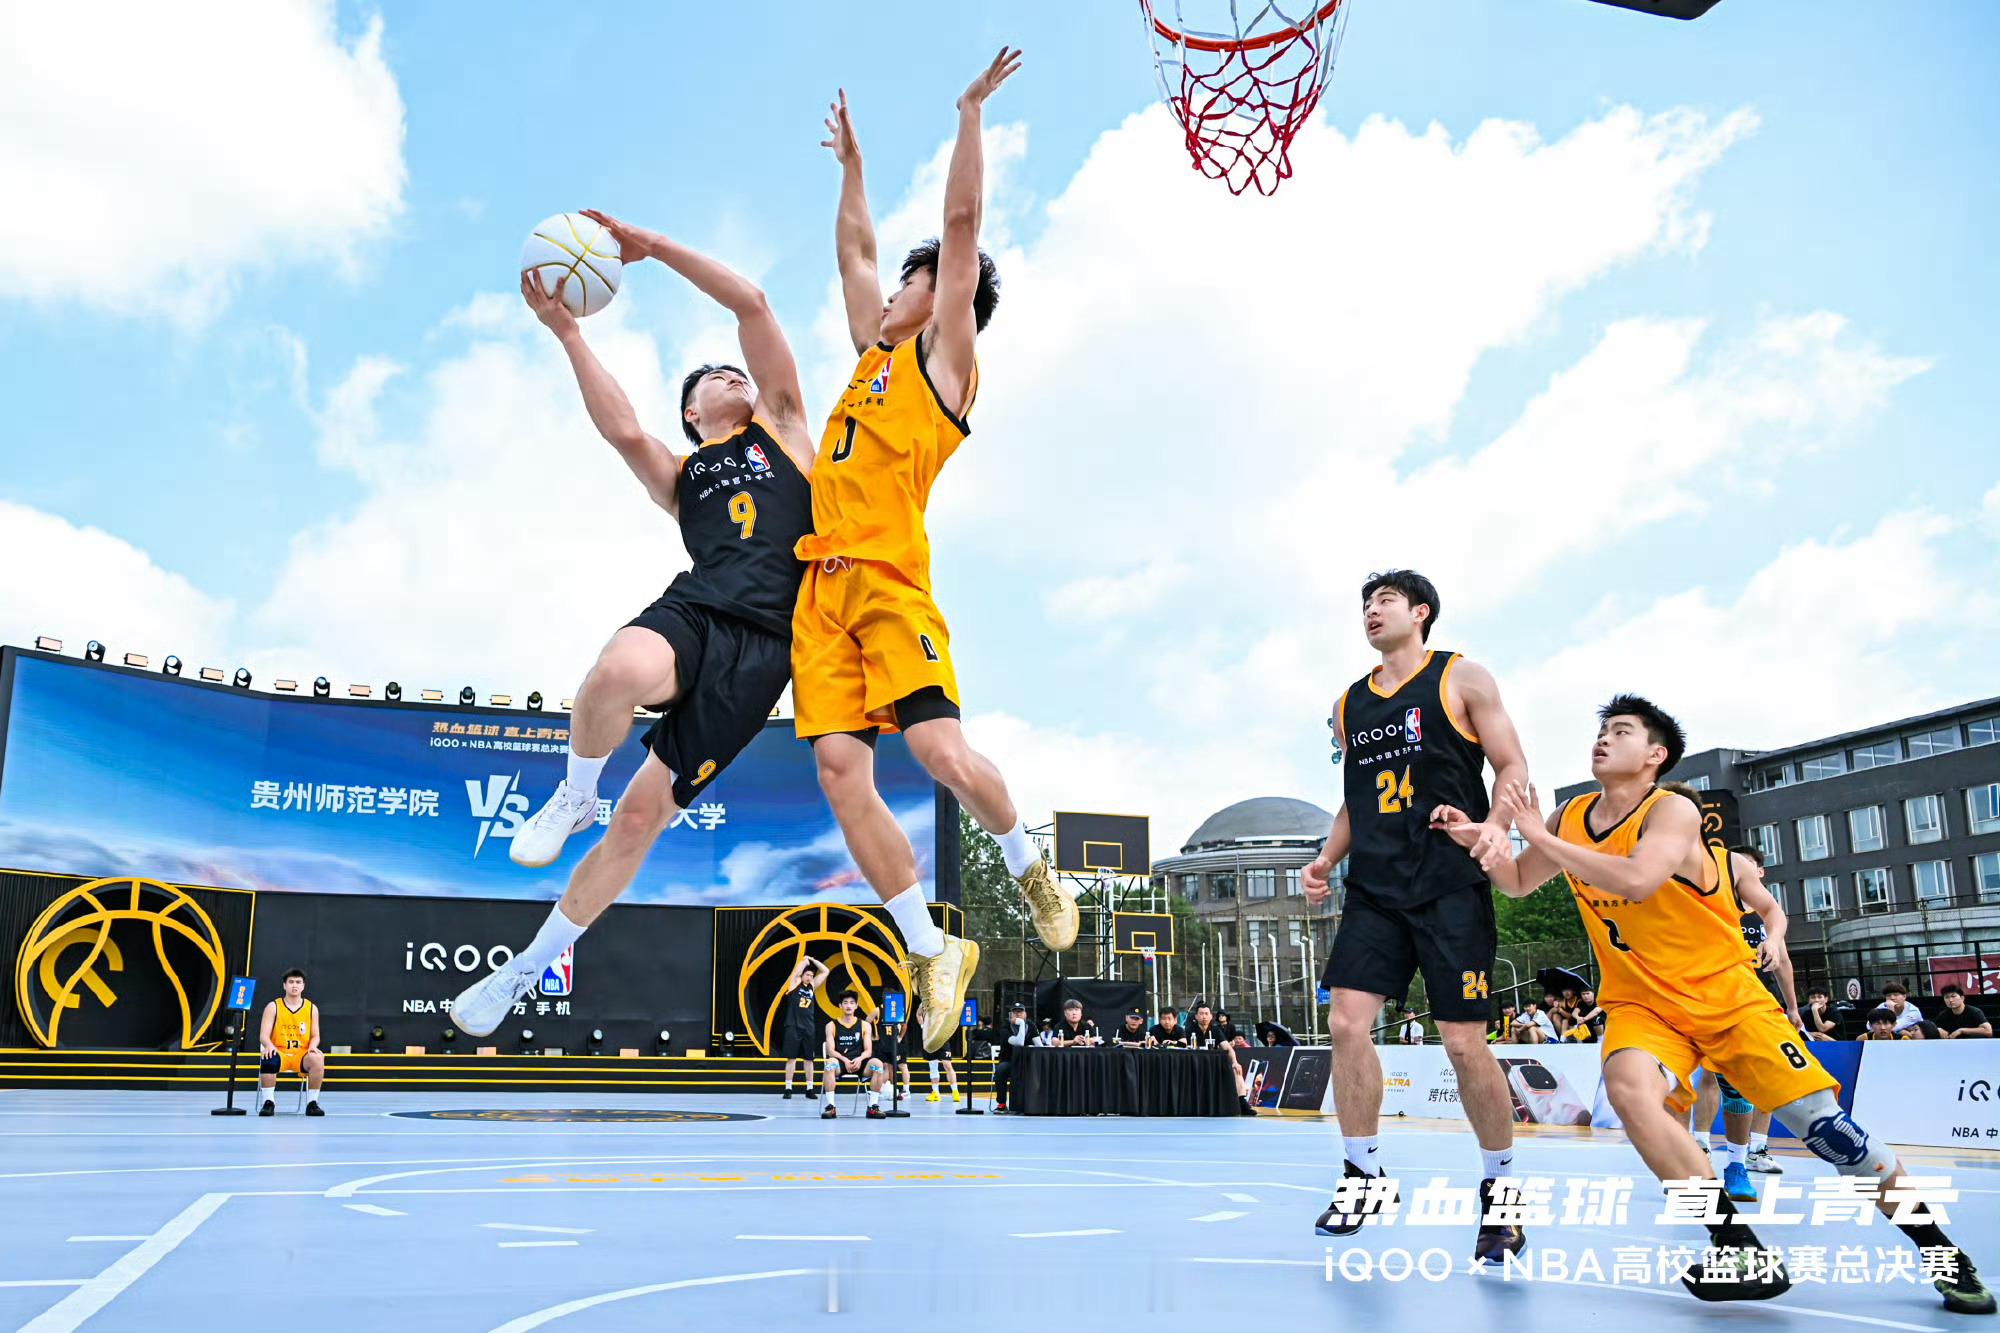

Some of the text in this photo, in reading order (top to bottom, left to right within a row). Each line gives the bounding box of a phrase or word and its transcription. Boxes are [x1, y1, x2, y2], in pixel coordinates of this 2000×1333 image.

[728, 491, 757, 540] 9
[430, 737, 460, 748] iQOO
[432, 721, 570, 740] 热血篮球 直上青云
[1351, 724, 1398, 747] iQOO
[690, 758, 718, 787] 9
[250, 780, 440, 817] 贵州师范学院
[1375, 763, 1415, 814] 24
[465, 769, 530, 860] VS
[405, 942, 514, 973] iQOO
[544, 978, 561, 992] NBA
[1462, 970, 1489, 1000] 24
[402, 1000, 437, 1014] NBA
[1779, 1041, 1808, 1070] 8
[1957, 1079, 2000, 1102] iQ
[1951, 1126, 1999, 1139] NBA 中
